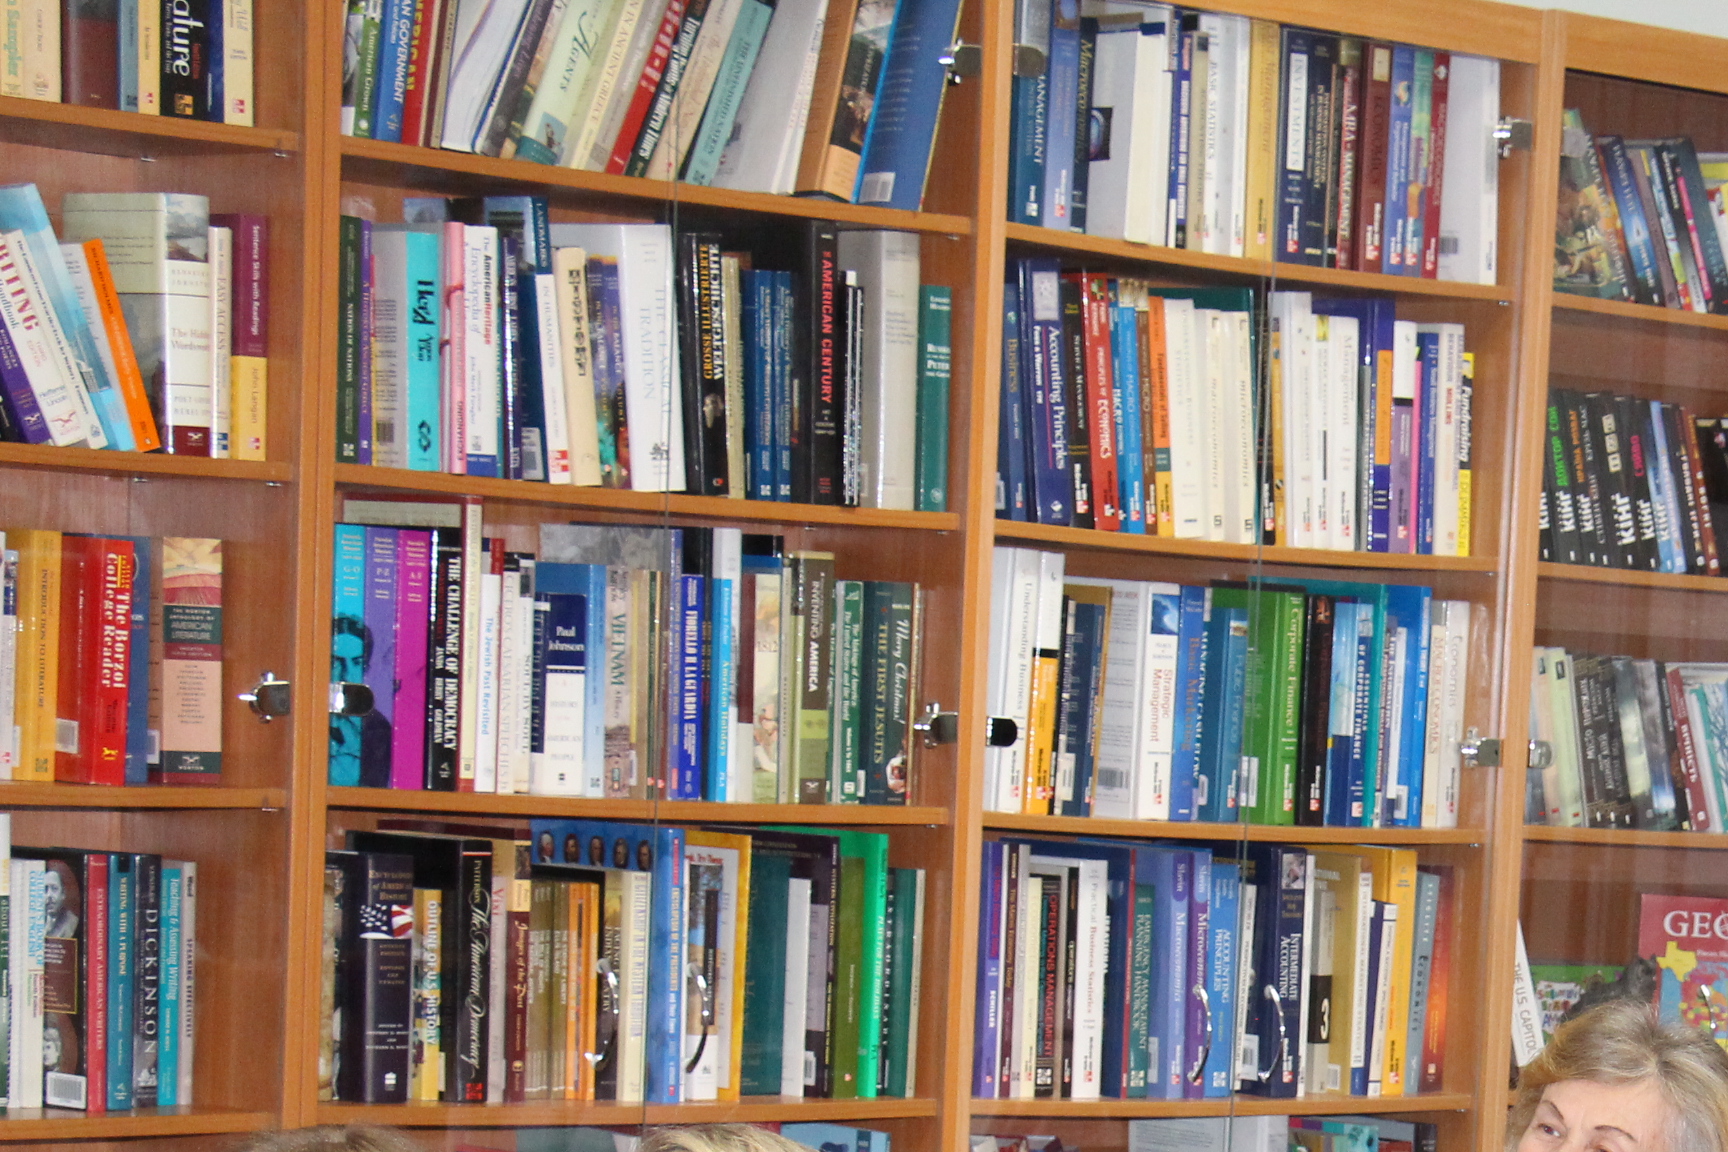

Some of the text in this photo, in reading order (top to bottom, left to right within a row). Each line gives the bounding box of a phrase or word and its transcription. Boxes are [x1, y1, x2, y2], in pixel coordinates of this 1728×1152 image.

[362, 27, 379, 111] American Grown
[392, 20, 410, 103] GOVERNMENT
[1291, 58, 1306, 167] INVESTMENTS
[536, 203, 548, 267] LANDMARKS
[251, 301, 260, 335] Readings
[820, 261, 832, 403] AMERICAN CENTURY
[1008, 339, 1017, 392] Business
[1048, 326, 1067, 469] Accounting Principles
[1126, 374, 1136, 413] MACRO
[1142, 378, 1151, 411] MICRO
[1157, 353, 1166, 402] Fundamentals
[1097, 399, 1112, 459] ECONOMICS
[1159, 414, 1168, 439] Selling
[1458, 386, 1472, 462] Fundraising
[102, 553, 118, 687] College Reader
[113, 592, 129, 688] The Borzoi
[443, 557, 460, 750] THE CHALLENGE OF DEMOCRACY
[482, 637, 493, 667] Jewish
[485, 618, 494, 633] The
[549, 640, 584, 651] Johnson
[556, 626, 576, 637] Paul
[611, 613, 627, 686] VIETNAM
[808, 580, 820, 692] INVENTING AMERICA
[1016, 582, 1033, 710] Understanding Business
[874, 622, 888, 764] THE FIRST JESUITS
[893, 620, 909, 724] Merry Christmas!
[1162, 669, 1173, 719] Strategic
[1230, 655, 1243, 743] Public Finance
[1285, 608, 1298, 727] Corporate Finance
[1355, 660, 1364, 714] CORPORATE
[481, 694, 491, 736] Revisited
[719, 660, 730, 756] American Holidays
[1149, 669, 1162, 742] Management
[1353, 718, 1362, 760] FINANCE
[28, 871, 37, 913] COLLEGE
[169, 878, 180, 915] Teaching
[426, 901, 438, 949] OUTLINE
[168, 927, 178, 964] Assessing
[426, 953, 438, 967] OF
[1087, 883, 1098, 1013] Practical Business Statistics
[1174, 863, 1185, 1002] Slavin Macroeconomics
[1214, 929, 1223, 992] PRINCIPLES
[1221, 929, 1231, 1003] ACCOUNTING
[144, 909, 157, 1054] DICKINSON
[167, 967, 178, 1000] Writing
[1044, 895, 1057, 1057] OPERATIONS MANAGEMENT
[1132, 914, 1144, 1031] PLANNING HANDBOOK
[1139, 914, 1151, 1051] EMERGENCY MANAGEMENT
[1279, 936, 1290, 998] ACCOUNTING
[1289, 933, 1301, 1001] INTERMEDIATE
[426, 995, 438, 1045] HISTORY
